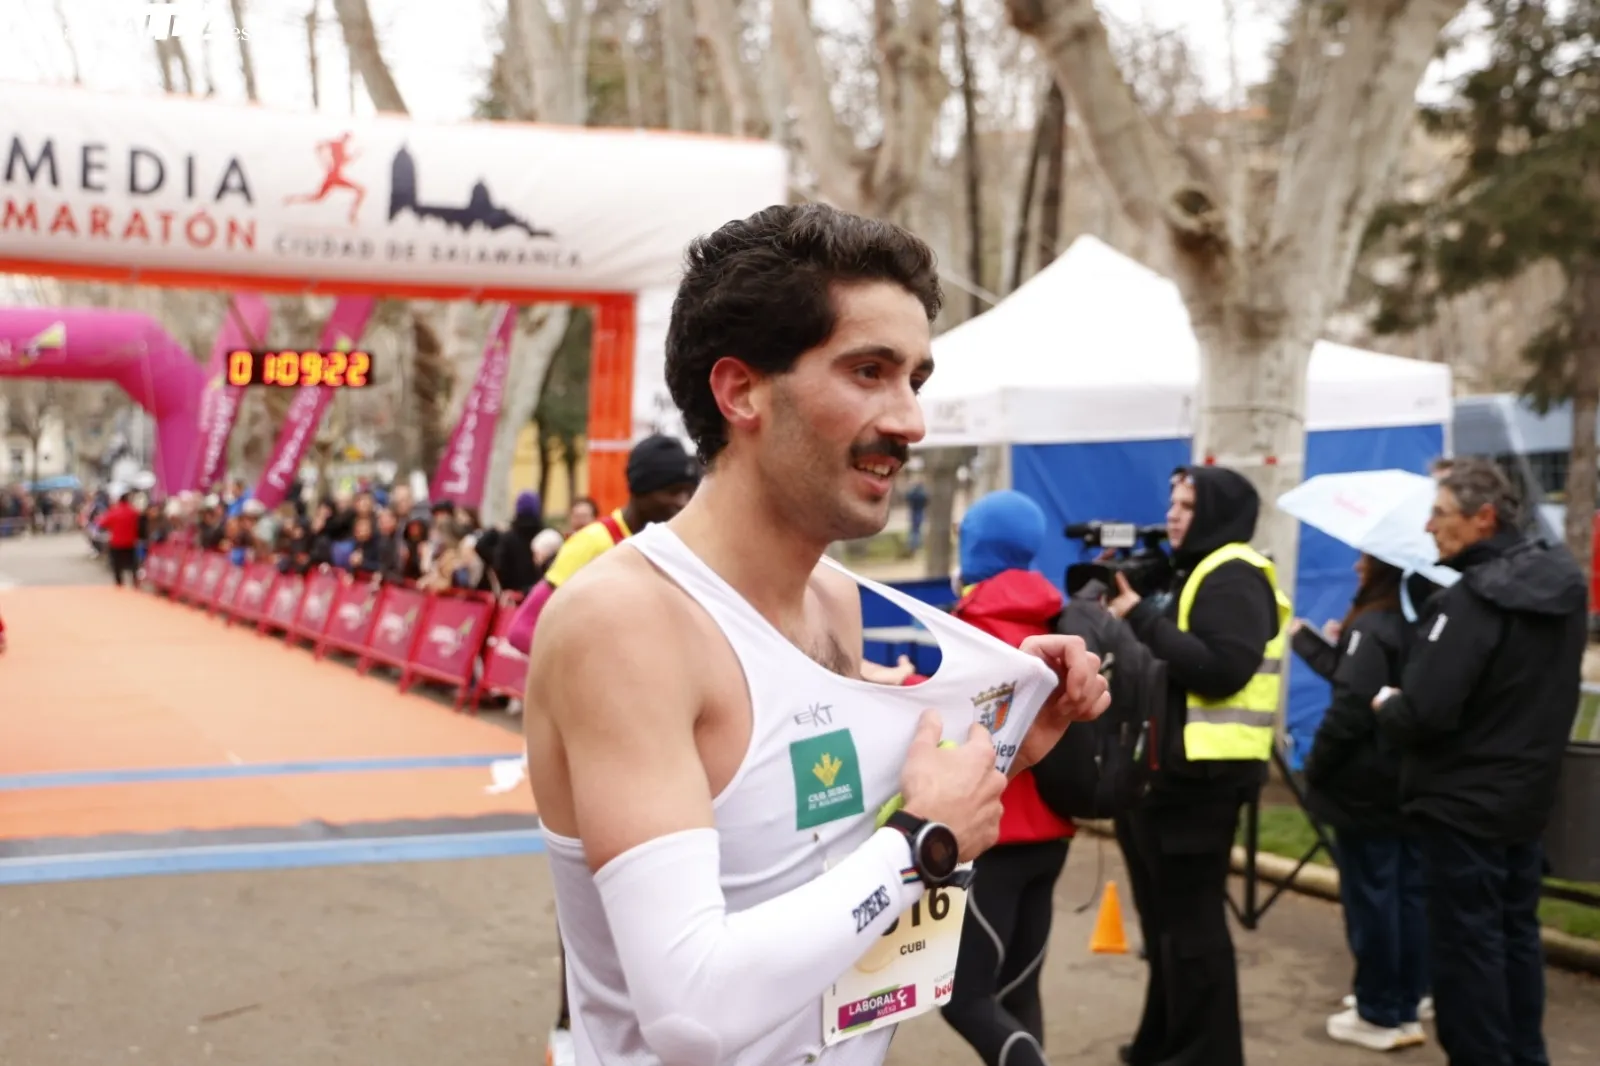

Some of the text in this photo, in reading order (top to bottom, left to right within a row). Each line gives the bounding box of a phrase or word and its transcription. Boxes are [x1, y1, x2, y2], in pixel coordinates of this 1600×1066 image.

[4, 136, 254, 205] MEDIA
[2, 199, 257, 250] MARATÓN
[274, 235, 583, 269] CIUDAD DE SALAMANCA
[229, 350, 252, 387] 0
[794, 701, 833, 727] EKT
[882, 886, 950, 936] 16
[899, 940, 926, 956] CUBI
[848, 992, 896, 1016] LABORAL
